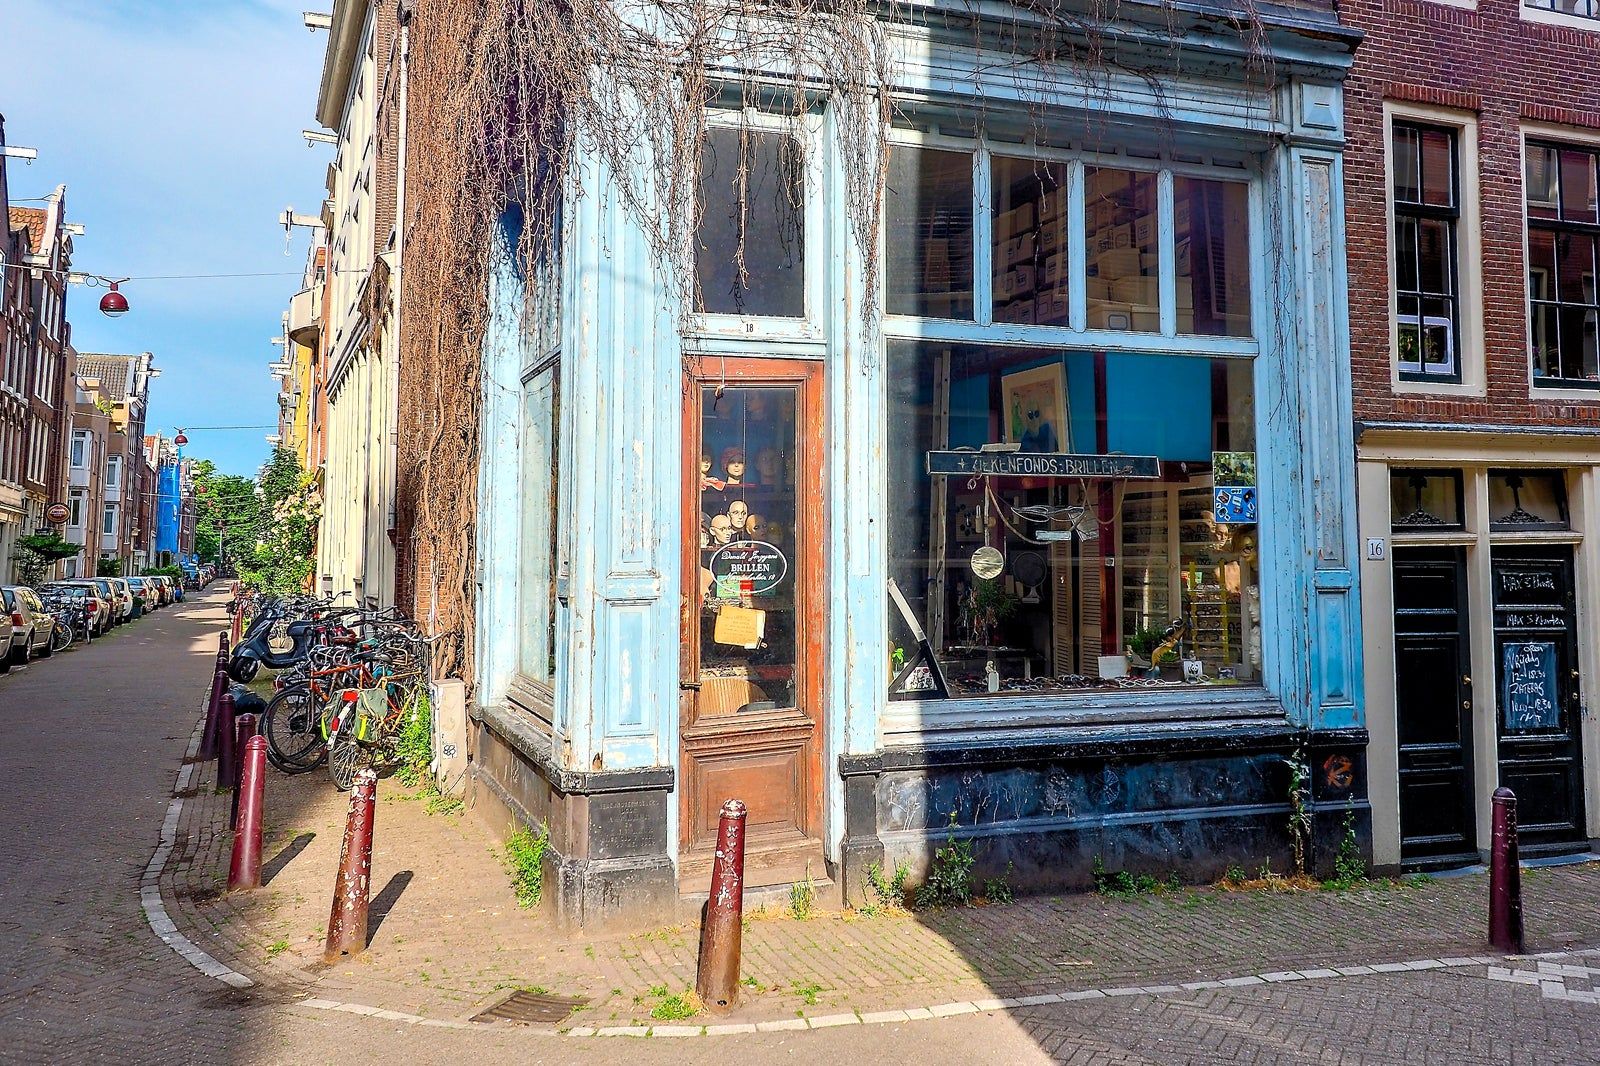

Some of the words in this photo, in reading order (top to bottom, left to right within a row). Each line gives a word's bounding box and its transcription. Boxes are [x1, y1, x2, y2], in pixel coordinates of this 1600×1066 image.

[745, 323, 754, 333] 18
[1370, 542, 1383, 556] 16
[731, 563, 771, 572] BRILLEN
